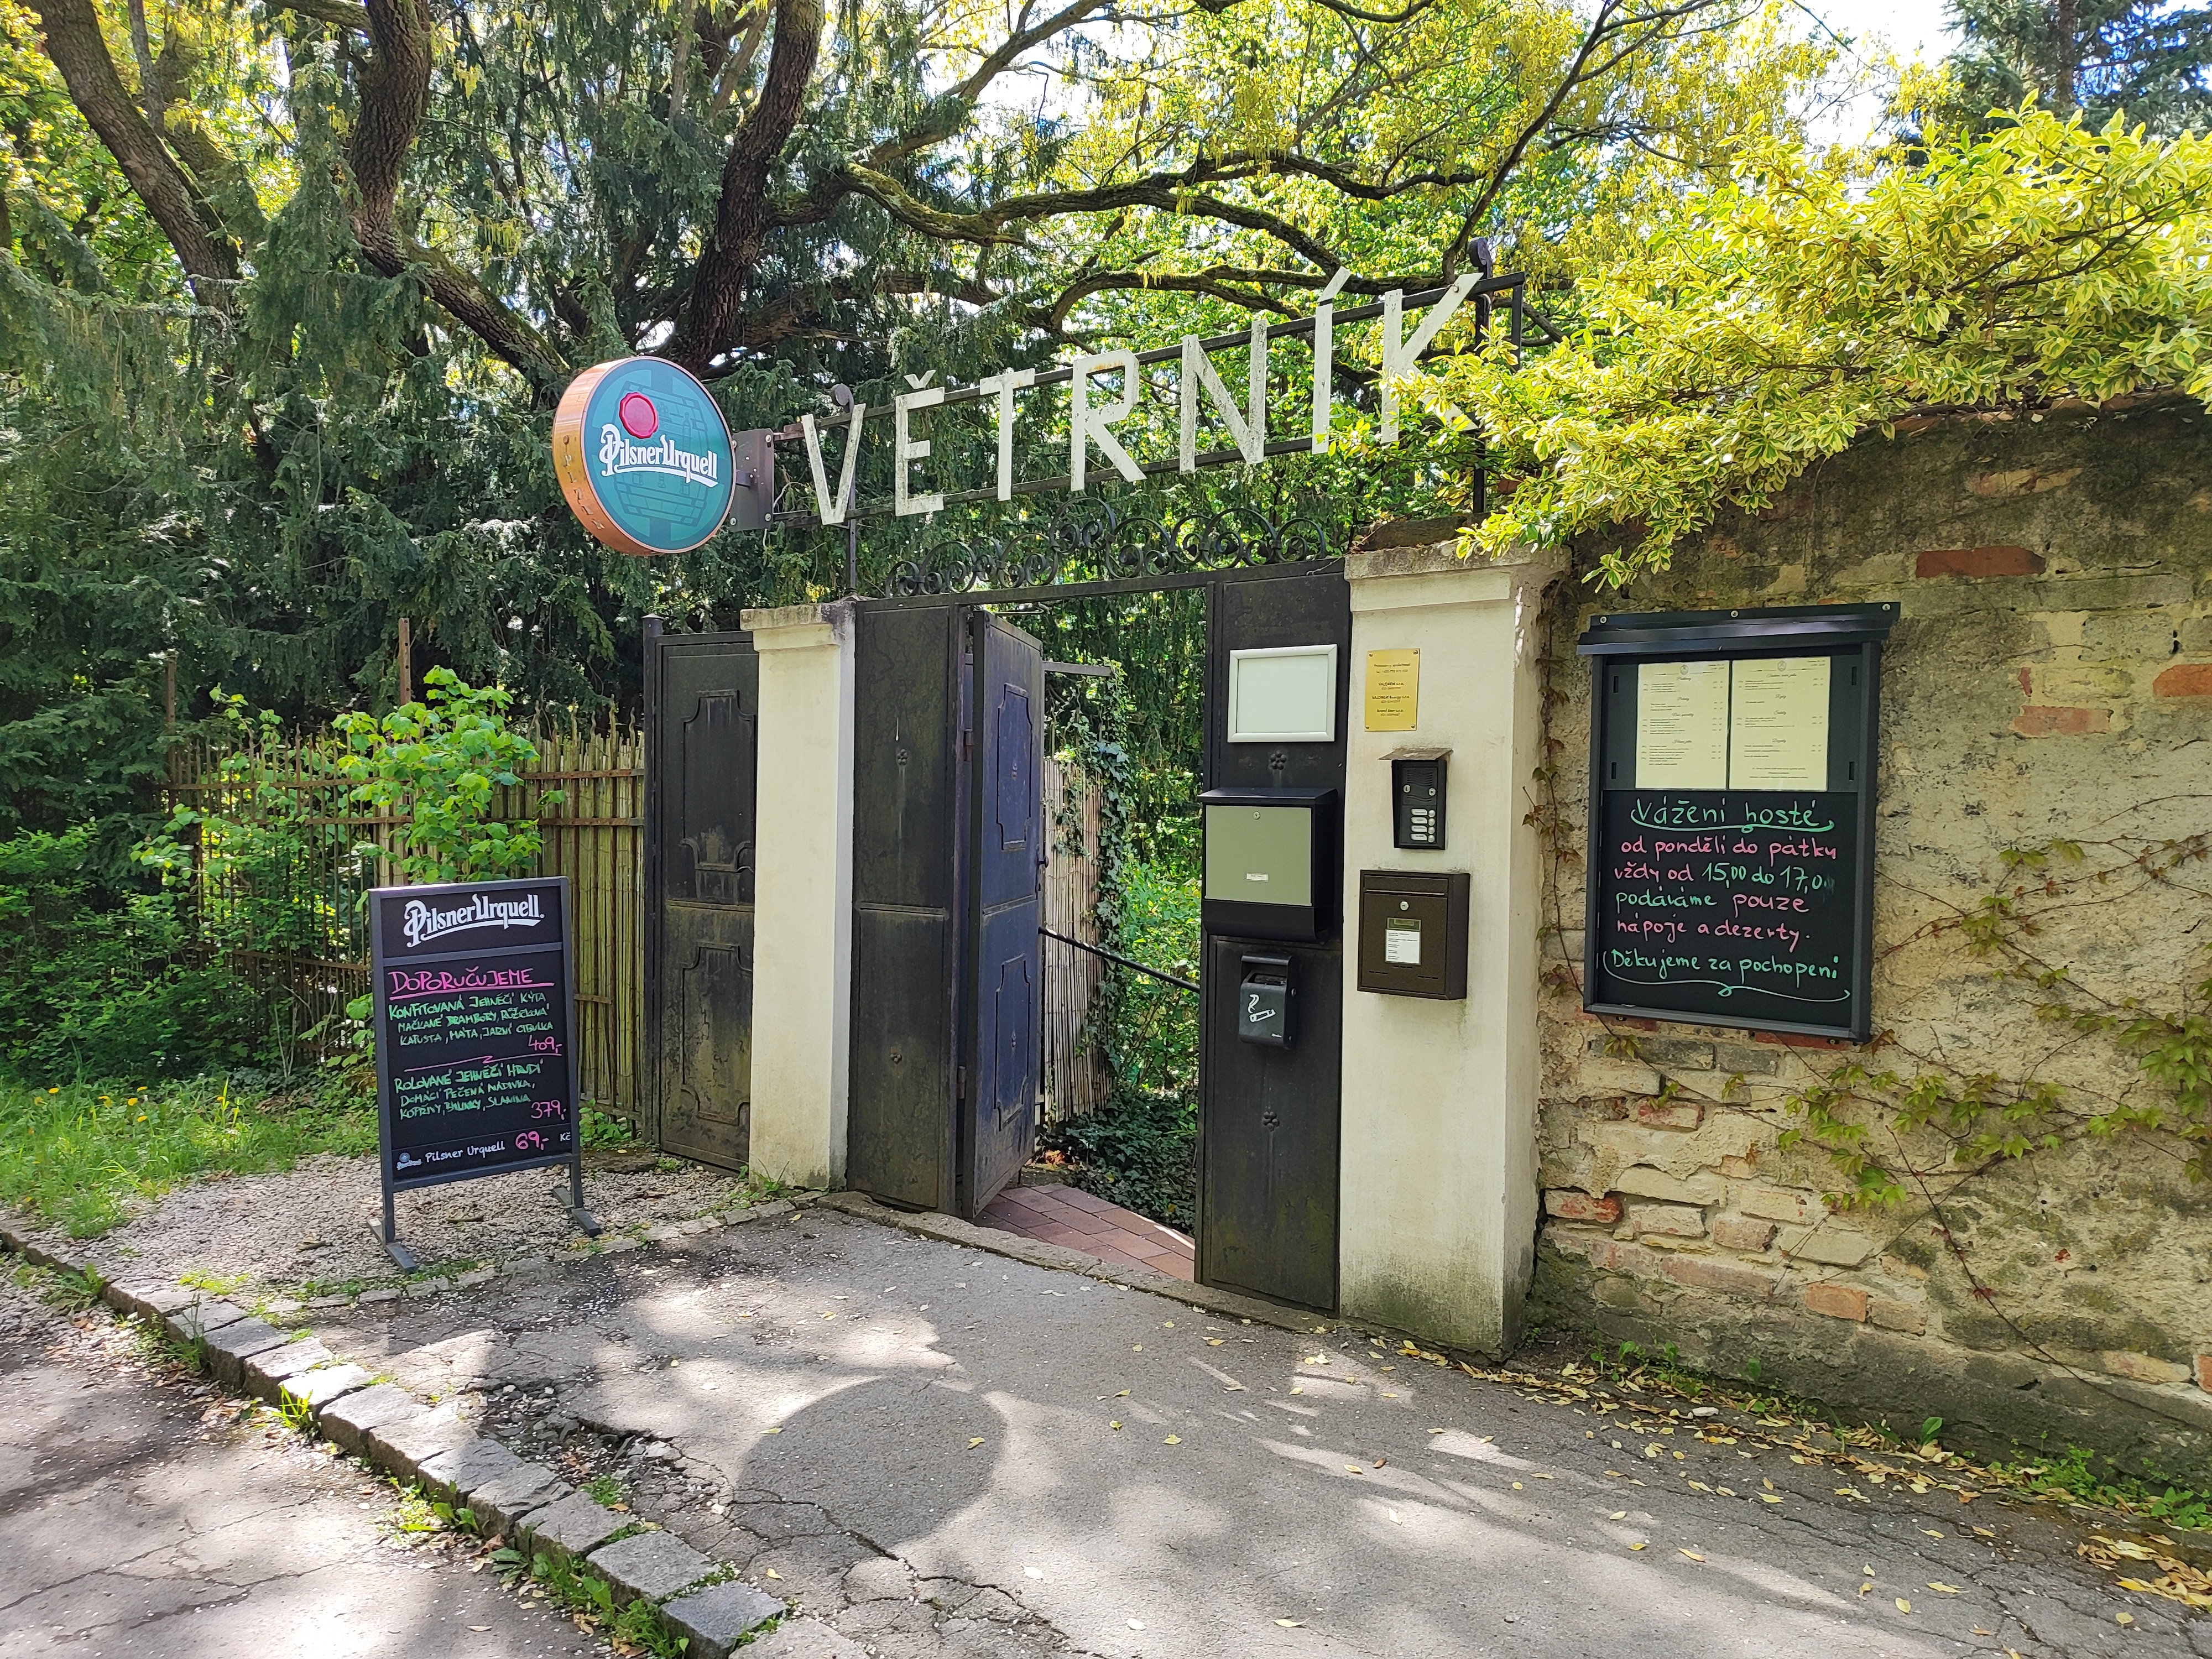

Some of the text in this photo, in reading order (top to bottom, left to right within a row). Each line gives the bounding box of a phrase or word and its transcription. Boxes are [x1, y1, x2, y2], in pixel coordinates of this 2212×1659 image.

[801, 266, 1483, 525] VĚTRNÍK
[599, 424, 717, 483] Pilsner Urquell
[1637, 796, 1819, 826] Vážení hosté
[1621, 835, 1836, 867] od pondělí do pátku
[1614, 861, 1659, 883] vždy
[1667, 863, 1694, 881] od
[1702, 862, 1746, 889] 15,00
[1751, 866, 1775, 885] do
[1616, 885, 1809, 918] podáváme pouze
[403, 900, 476, 948] Pilsner
[1617, 912, 1811, 953] nápoje a dezerty.
[388, 966, 533, 994] DOPORUČUJEME
[1611, 948, 1701, 980] Děkujeme
[1708, 958, 1731, 971] za
[389, 994, 465, 1020] KONFITOVANÁ
[394, 1068, 452, 1094] ROLOVANÉ
[444, 1082, 485, 1100] PEČENÁ
[425, 1150, 463, 1164] Pilsner
[467, 1140, 505, 1158] Urquell
[560, 1132, 571, 1142] Kč
